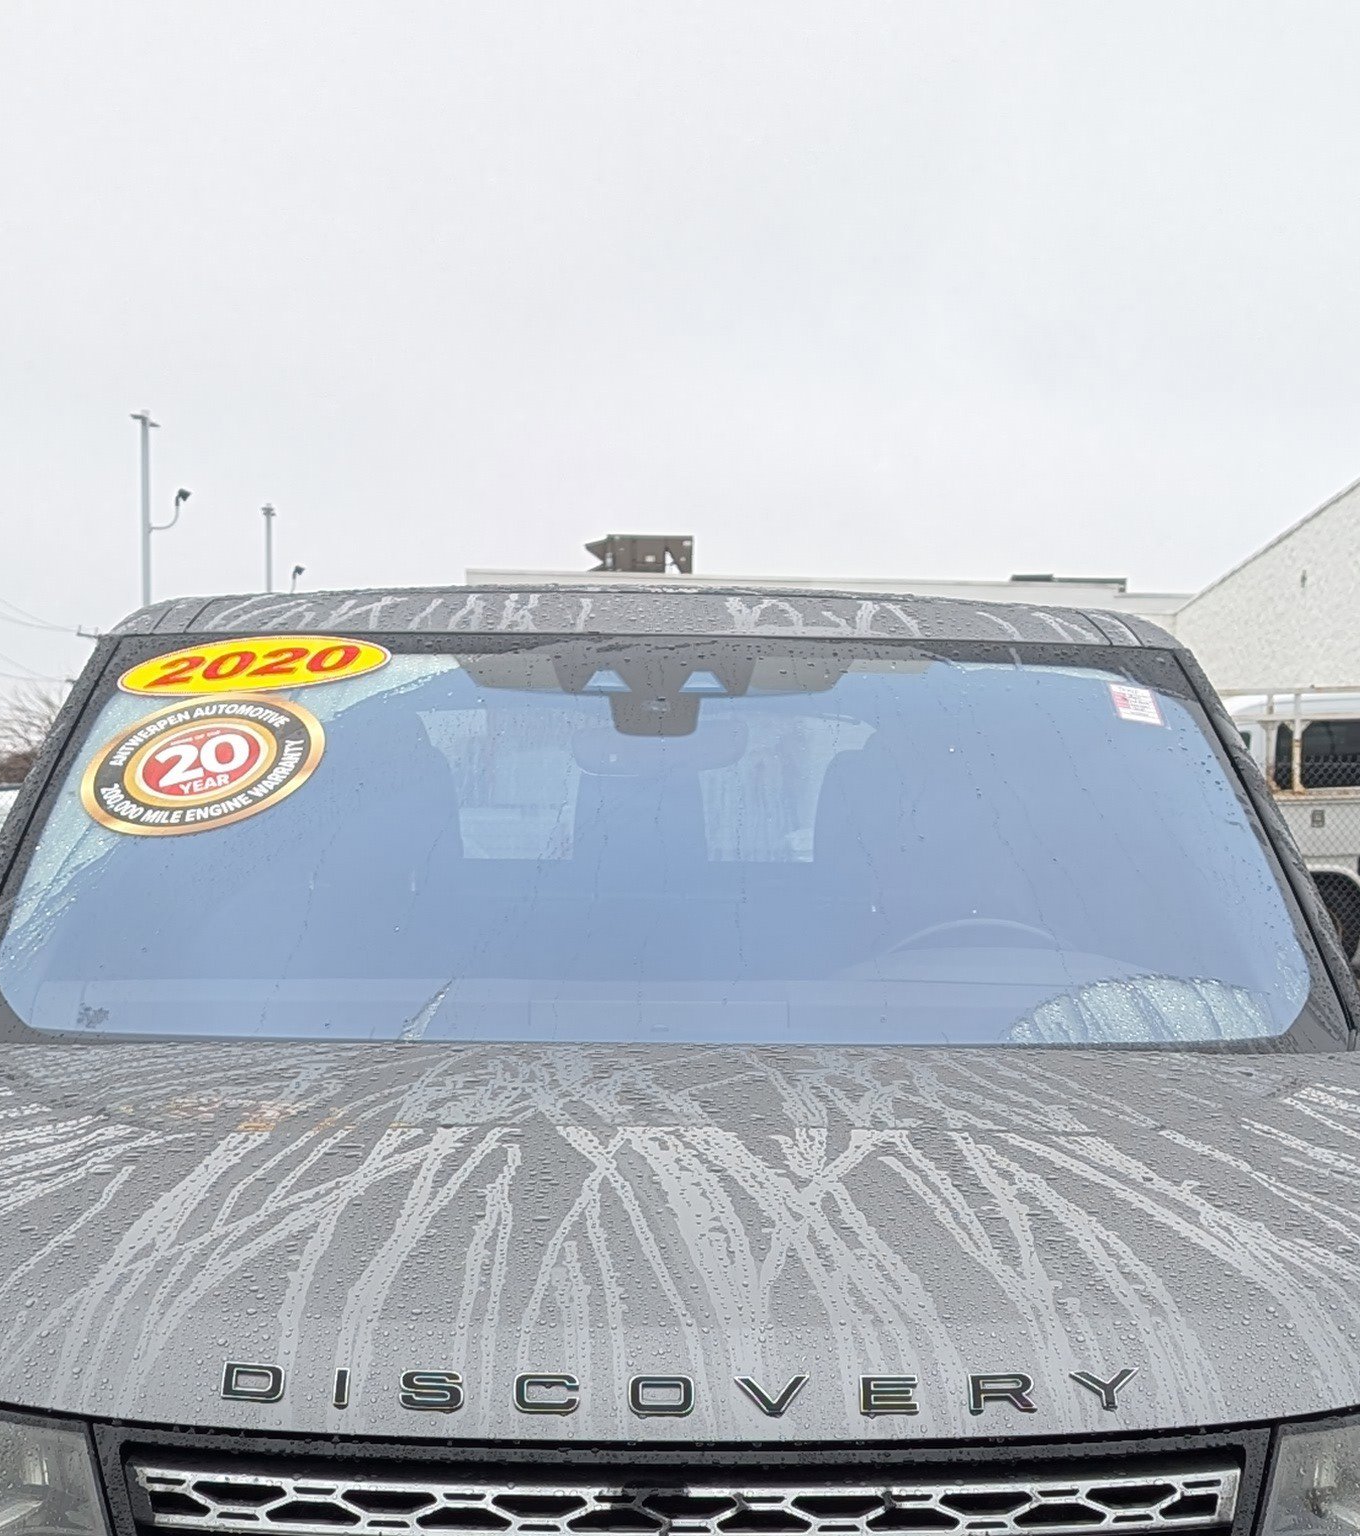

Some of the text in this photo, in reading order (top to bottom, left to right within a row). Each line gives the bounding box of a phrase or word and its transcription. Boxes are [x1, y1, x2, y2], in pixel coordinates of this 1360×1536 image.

[142, 645, 362, 689] 2020
[109, 711, 190, 767] ANTWERPEN
[193, 703, 290, 728] AUTOMOTIVE
[154, 733, 250, 788] 20
[100, 739, 305, 824] 200,000 MILE ENGINE WARRANTY
[179, 774, 230, 795] YEAR
[221, 1360, 1140, 1415] DISCOVERY
